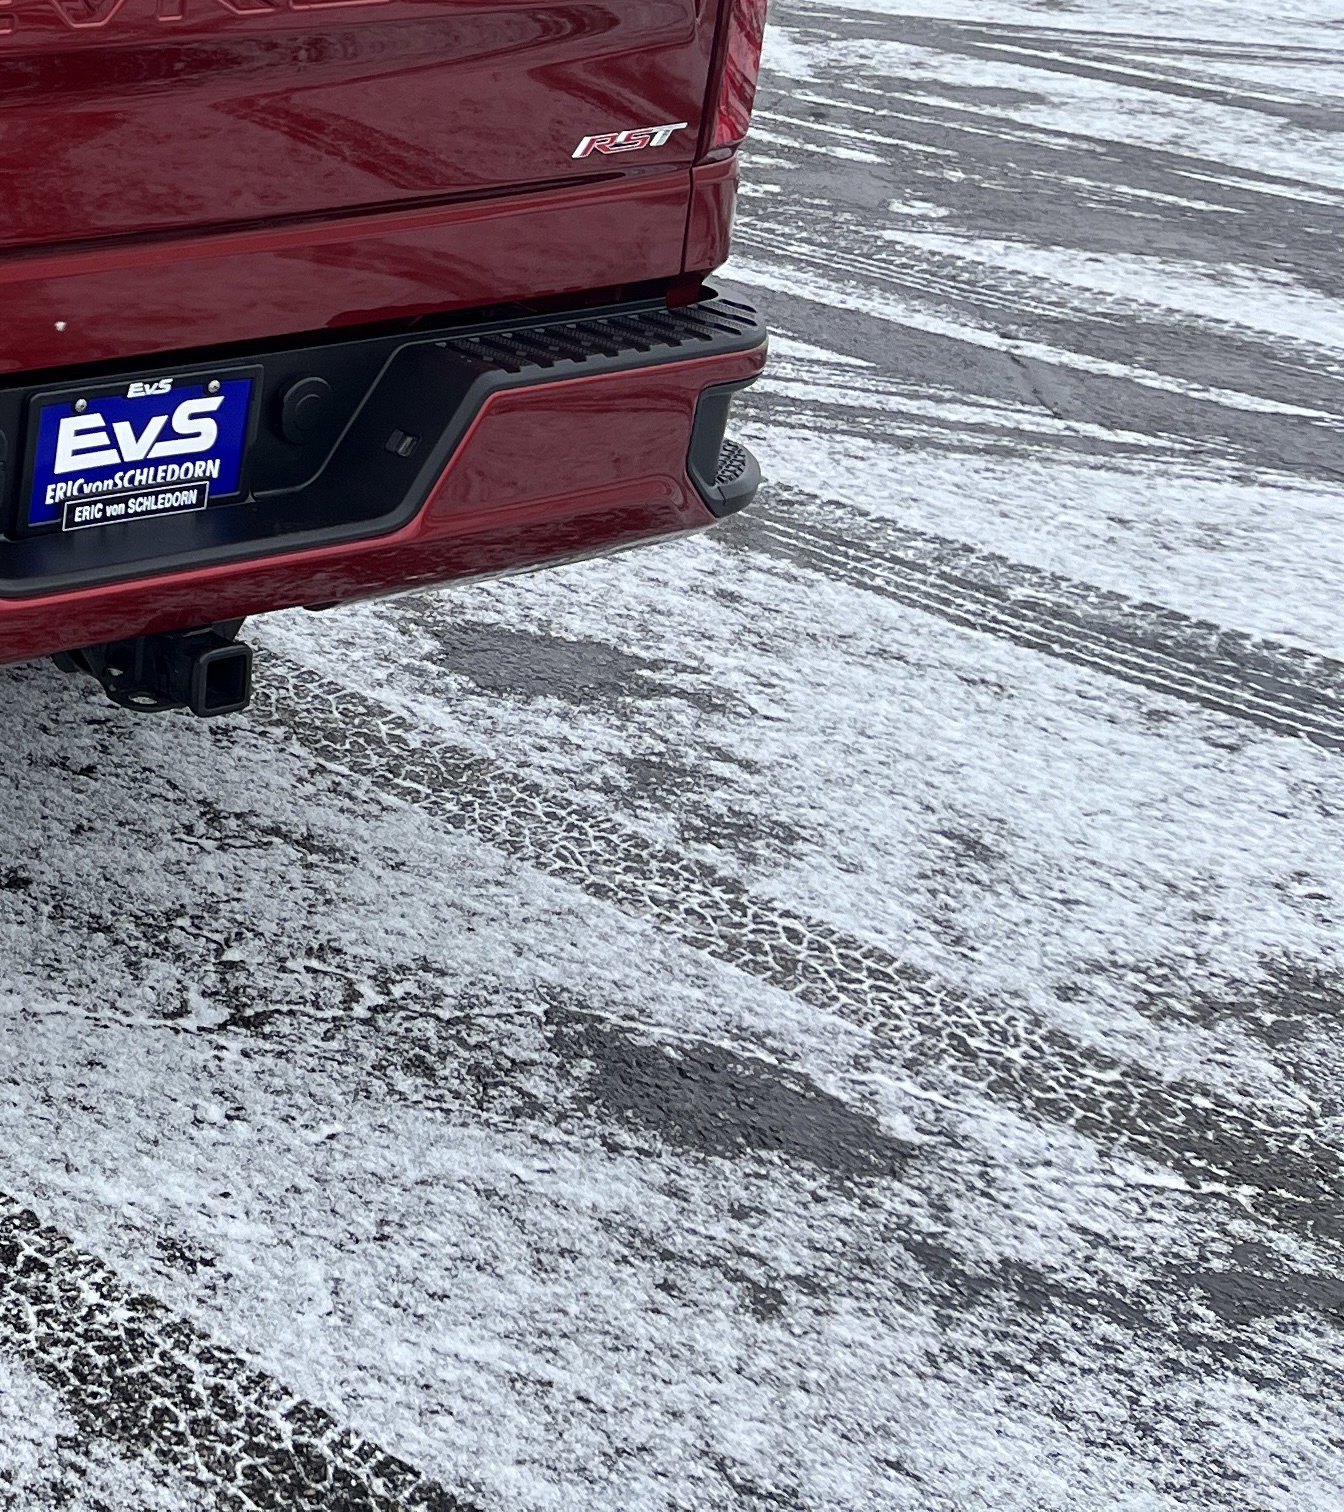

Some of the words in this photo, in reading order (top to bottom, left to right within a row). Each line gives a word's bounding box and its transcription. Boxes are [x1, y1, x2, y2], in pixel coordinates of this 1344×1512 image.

[571, 122, 689, 159] RST
[74, 504, 103, 522] ERIC
[105, 504, 125, 517] von
[127, 489, 198, 514] SCHLEDORN
